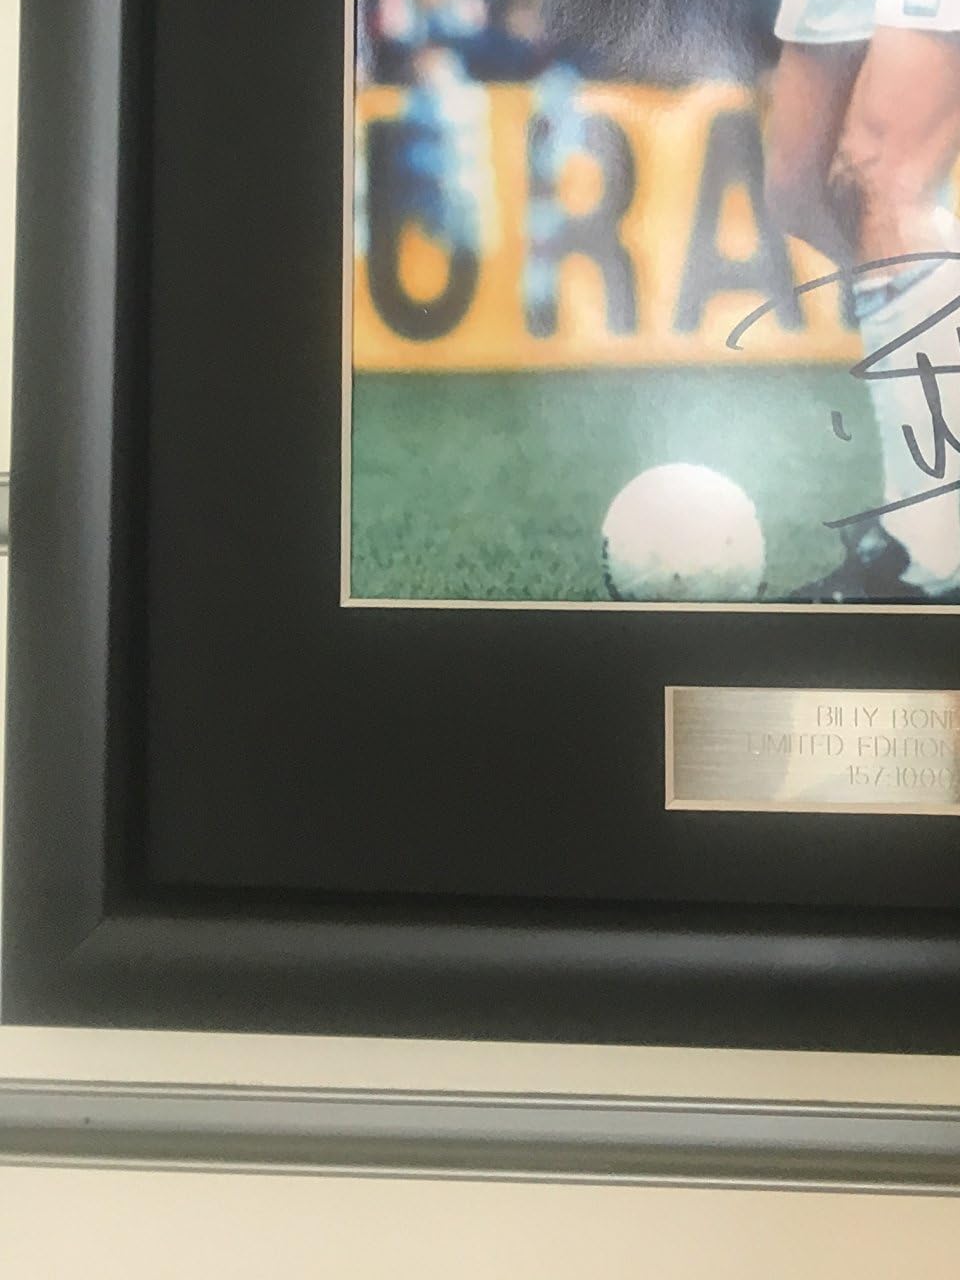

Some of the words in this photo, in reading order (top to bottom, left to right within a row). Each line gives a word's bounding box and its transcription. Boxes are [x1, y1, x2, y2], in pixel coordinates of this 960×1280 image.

[817, 705, 879, 728] BILLY
[746, 732, 844, 757] LIMITED
[857, 735, 955, 758] EDITION
